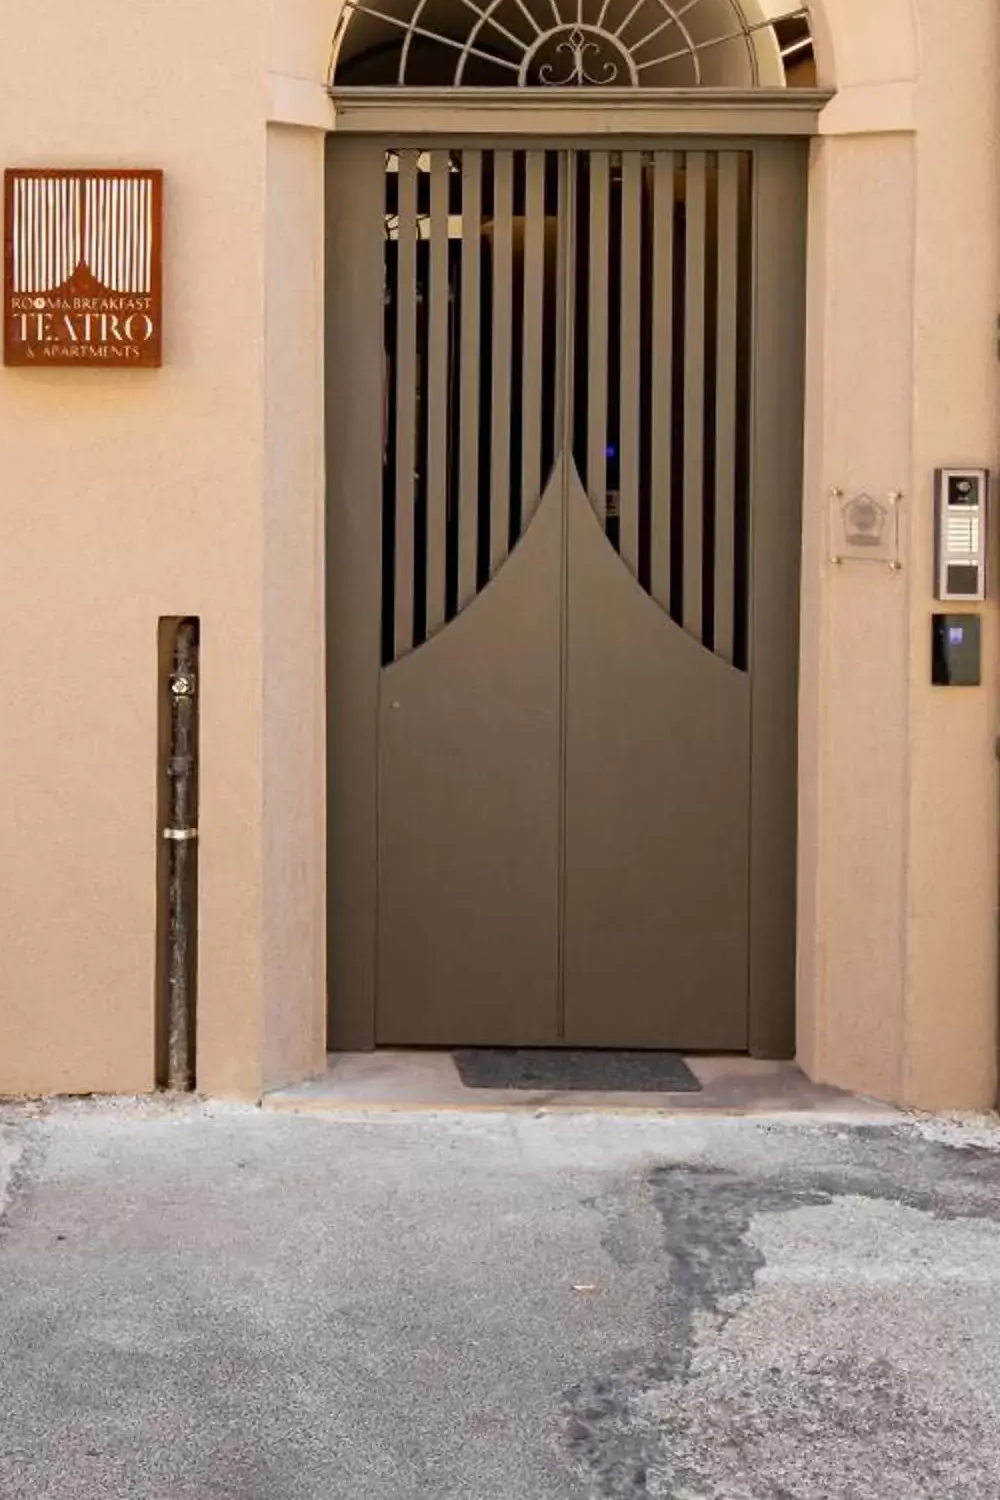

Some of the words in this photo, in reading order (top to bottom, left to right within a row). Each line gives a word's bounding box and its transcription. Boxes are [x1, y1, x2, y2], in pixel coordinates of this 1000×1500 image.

[73, 297, 152, 310] BREAKFAST
[12, 312, 154, 341] TEATRO
[26, 347, 35, 358] &
[43, 345, 140, 358] APARTMENTS
